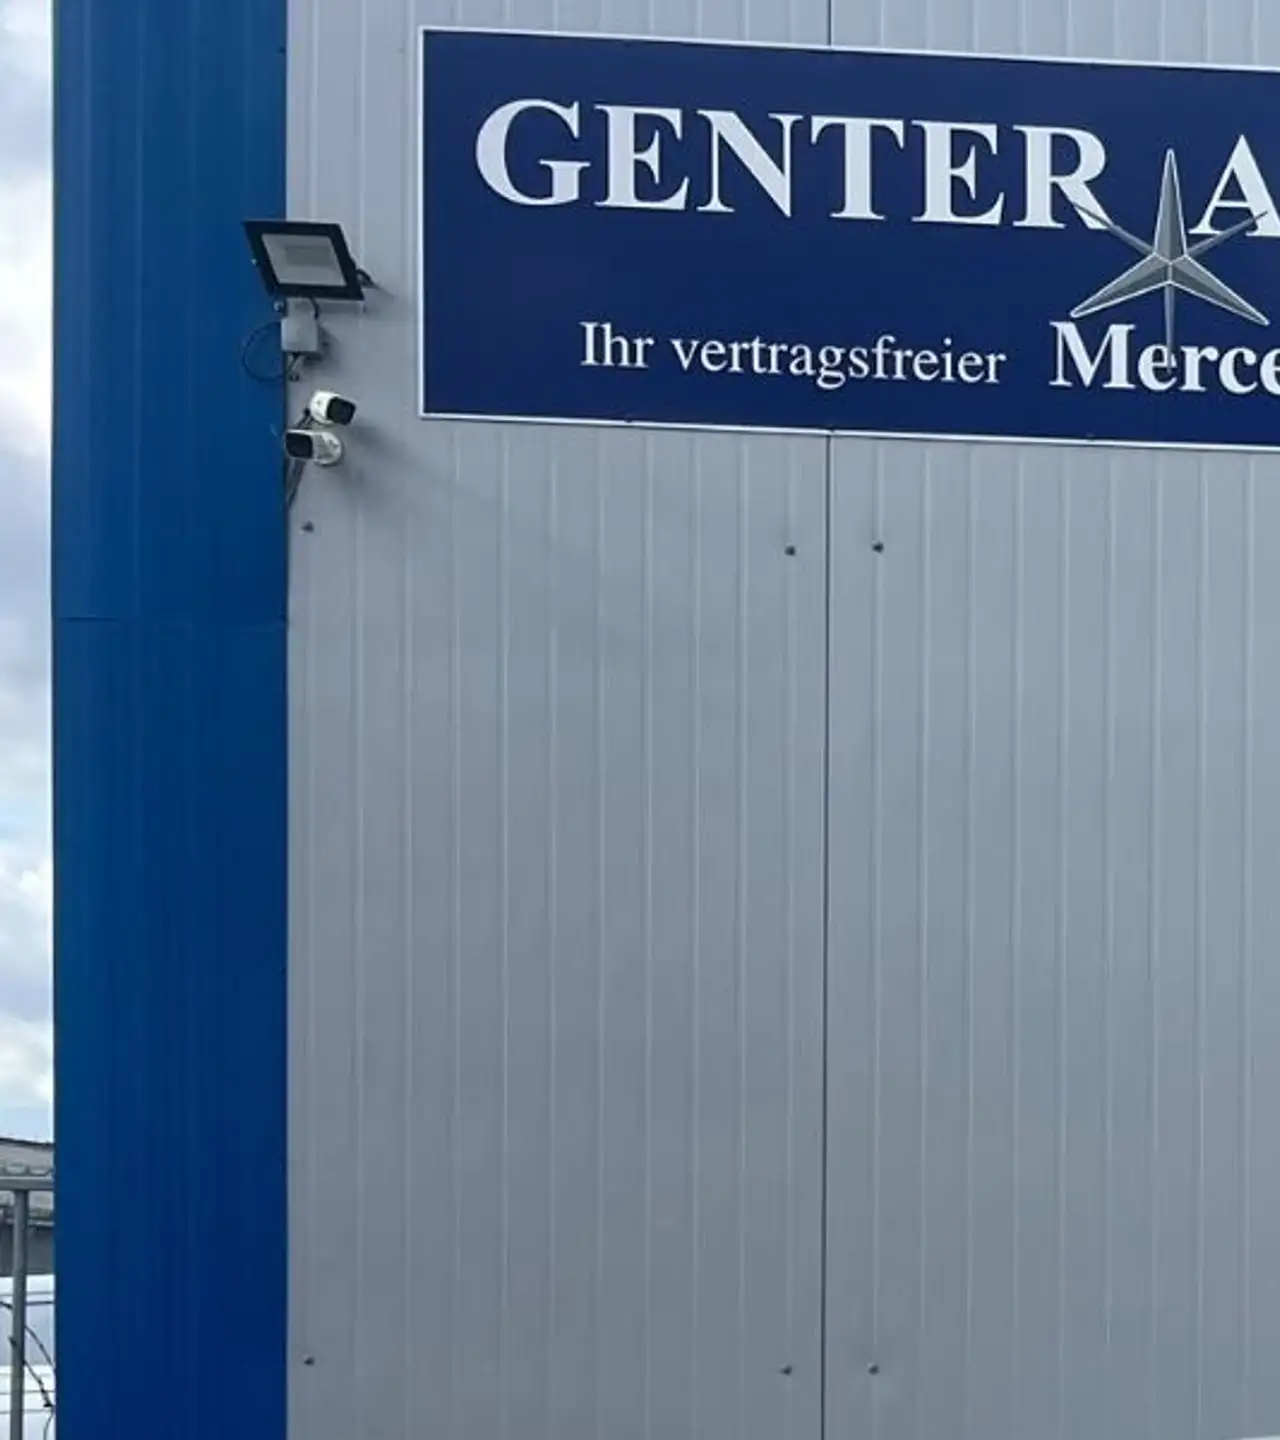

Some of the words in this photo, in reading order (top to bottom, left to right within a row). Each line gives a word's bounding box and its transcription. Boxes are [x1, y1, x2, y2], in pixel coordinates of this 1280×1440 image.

[475, 97, 1116, 231] GENTER
[580, 321, 655, 371] Ihr
[671, 334, 1007, 389] vertragsfreier
